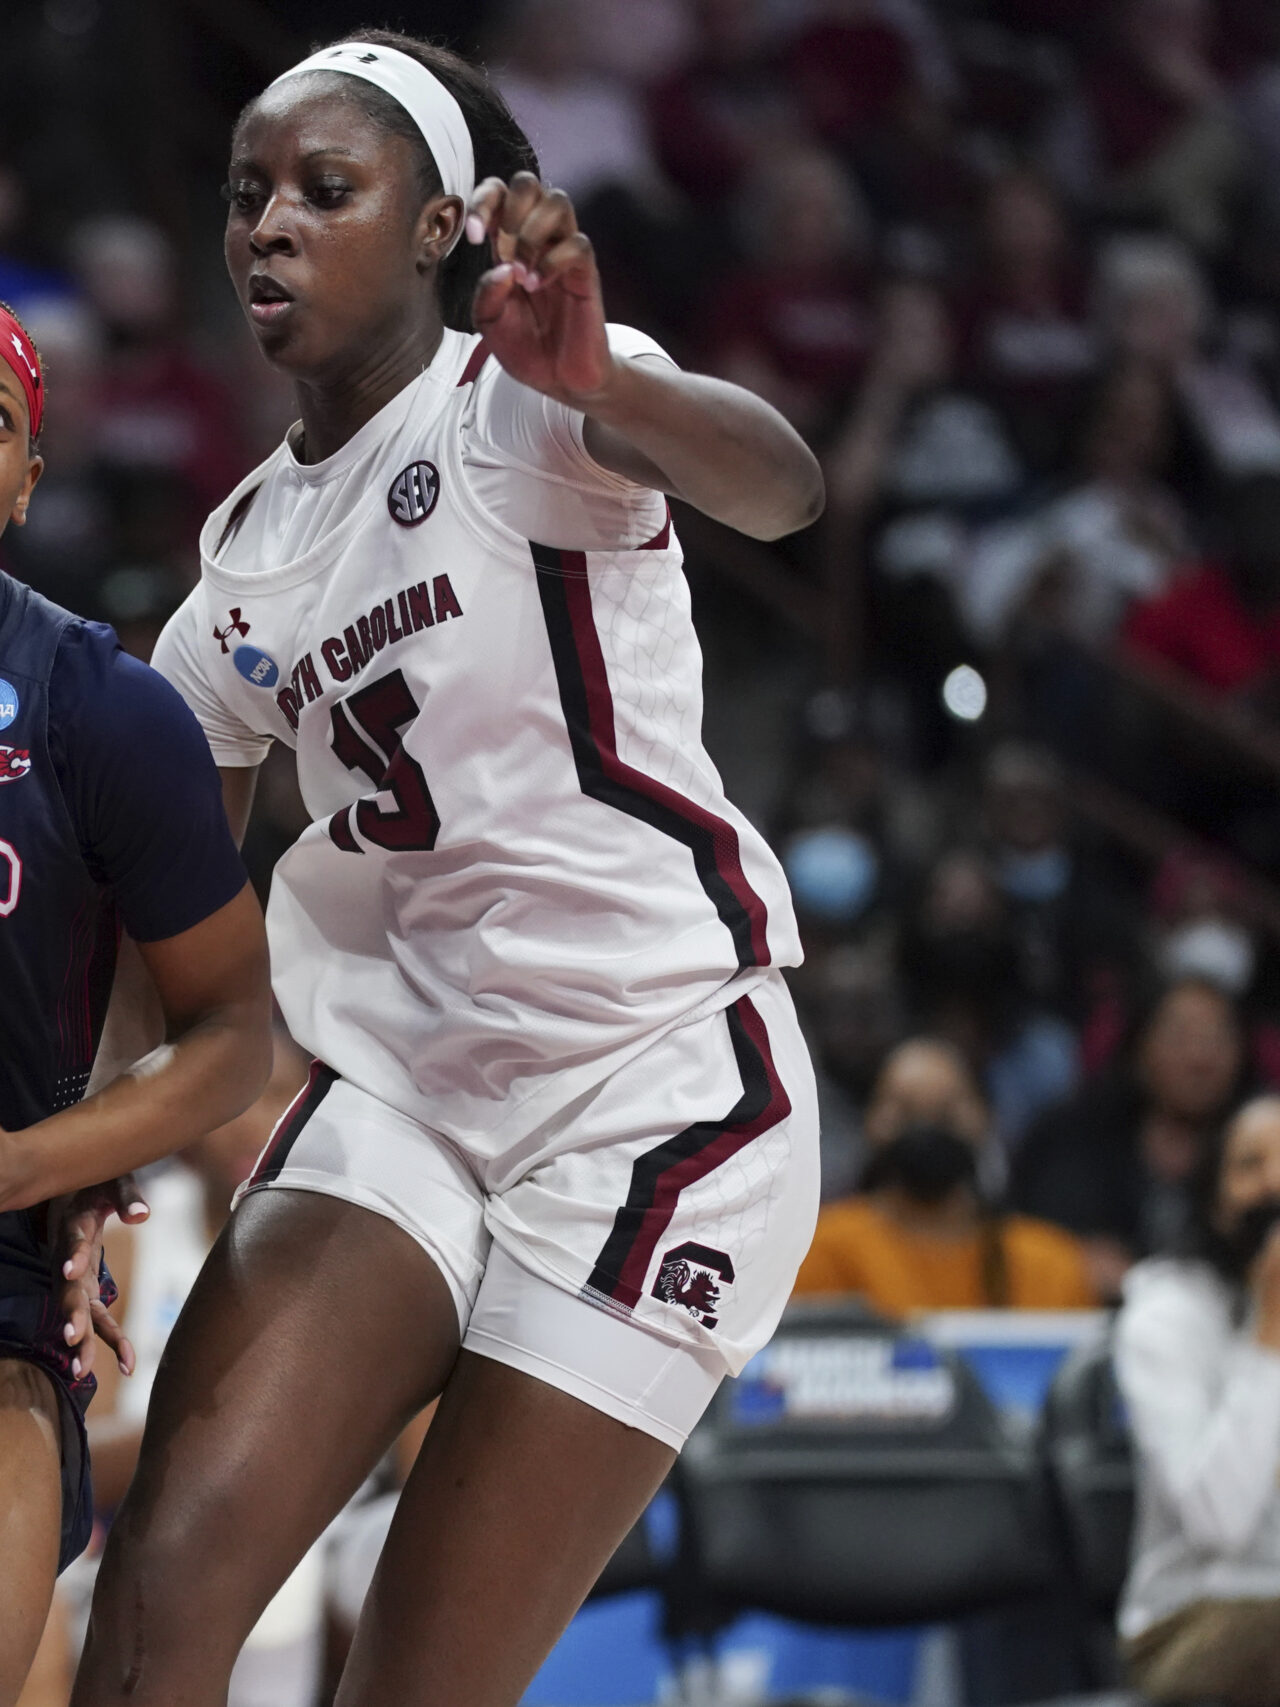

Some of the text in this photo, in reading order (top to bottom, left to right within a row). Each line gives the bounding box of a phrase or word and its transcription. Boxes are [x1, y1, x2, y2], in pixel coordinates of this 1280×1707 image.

[392, 464, 436, 520] SEC
[320, 573, 464, 682] CAROLINA
[249, 657, 273, 684] NCAA
[328, 667, 442, 855] 15
